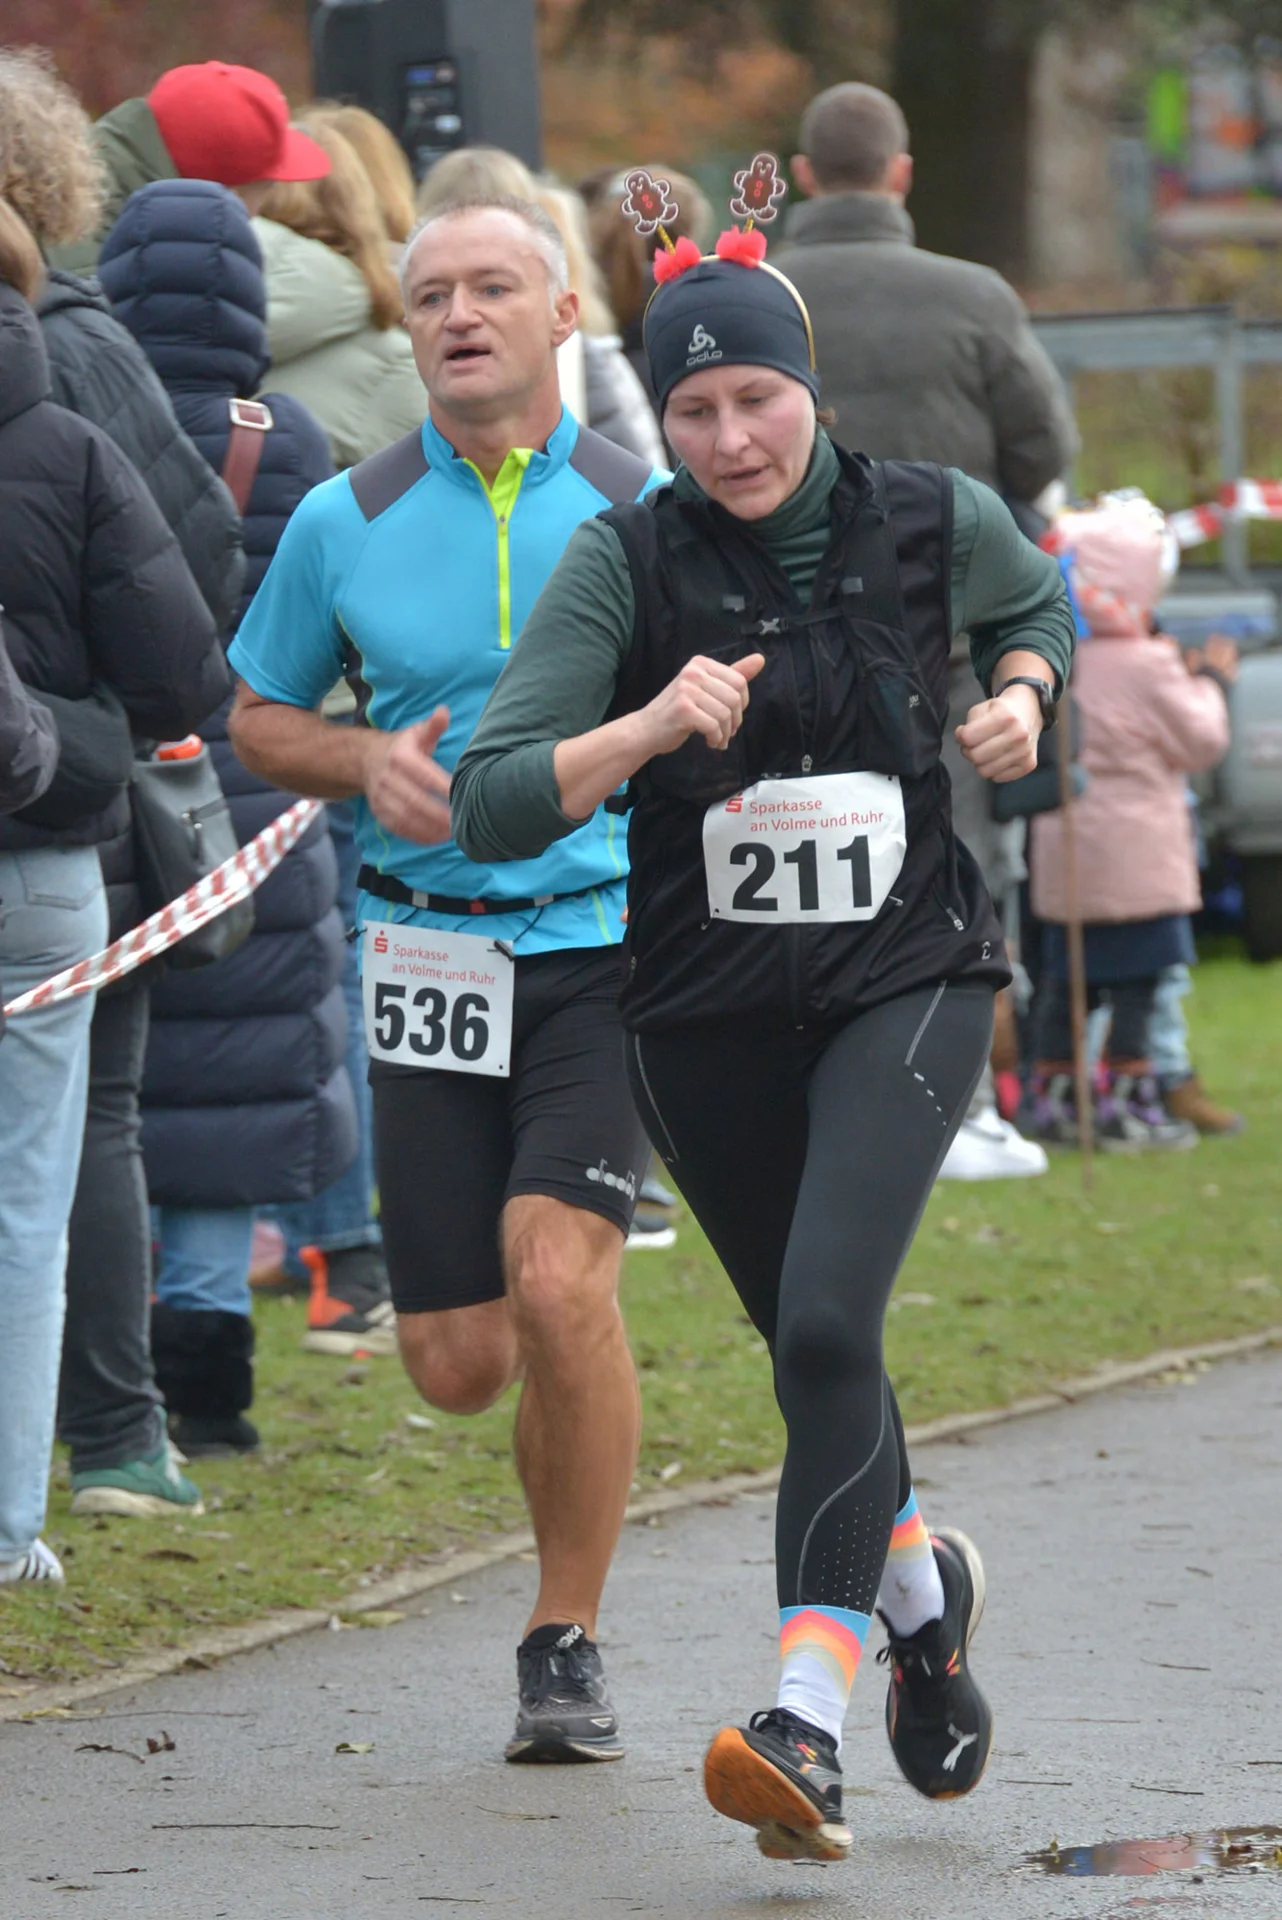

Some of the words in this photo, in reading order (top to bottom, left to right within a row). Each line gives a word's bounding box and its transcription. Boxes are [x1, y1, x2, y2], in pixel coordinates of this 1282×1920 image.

[686, 350, 723, 367] odlo
[749, 799, 822, 815] Sparkasse
[750, 821, 768, 832] an
[771, 817, 817, 831] Volme
[820, 814, 847, 827] und
[850, 811, 884, 825] Ruhr
[730, 834, 873, 911] 211
[393, 944, 449, 962] Sparkasse
[392, 964, 406, 973] an
[408, 964, 443, 979] Volme
[444, 971, 467, 981] und
[469, 971, 496, 984] Ruhr
[375, 982, 490, 1061] 536
